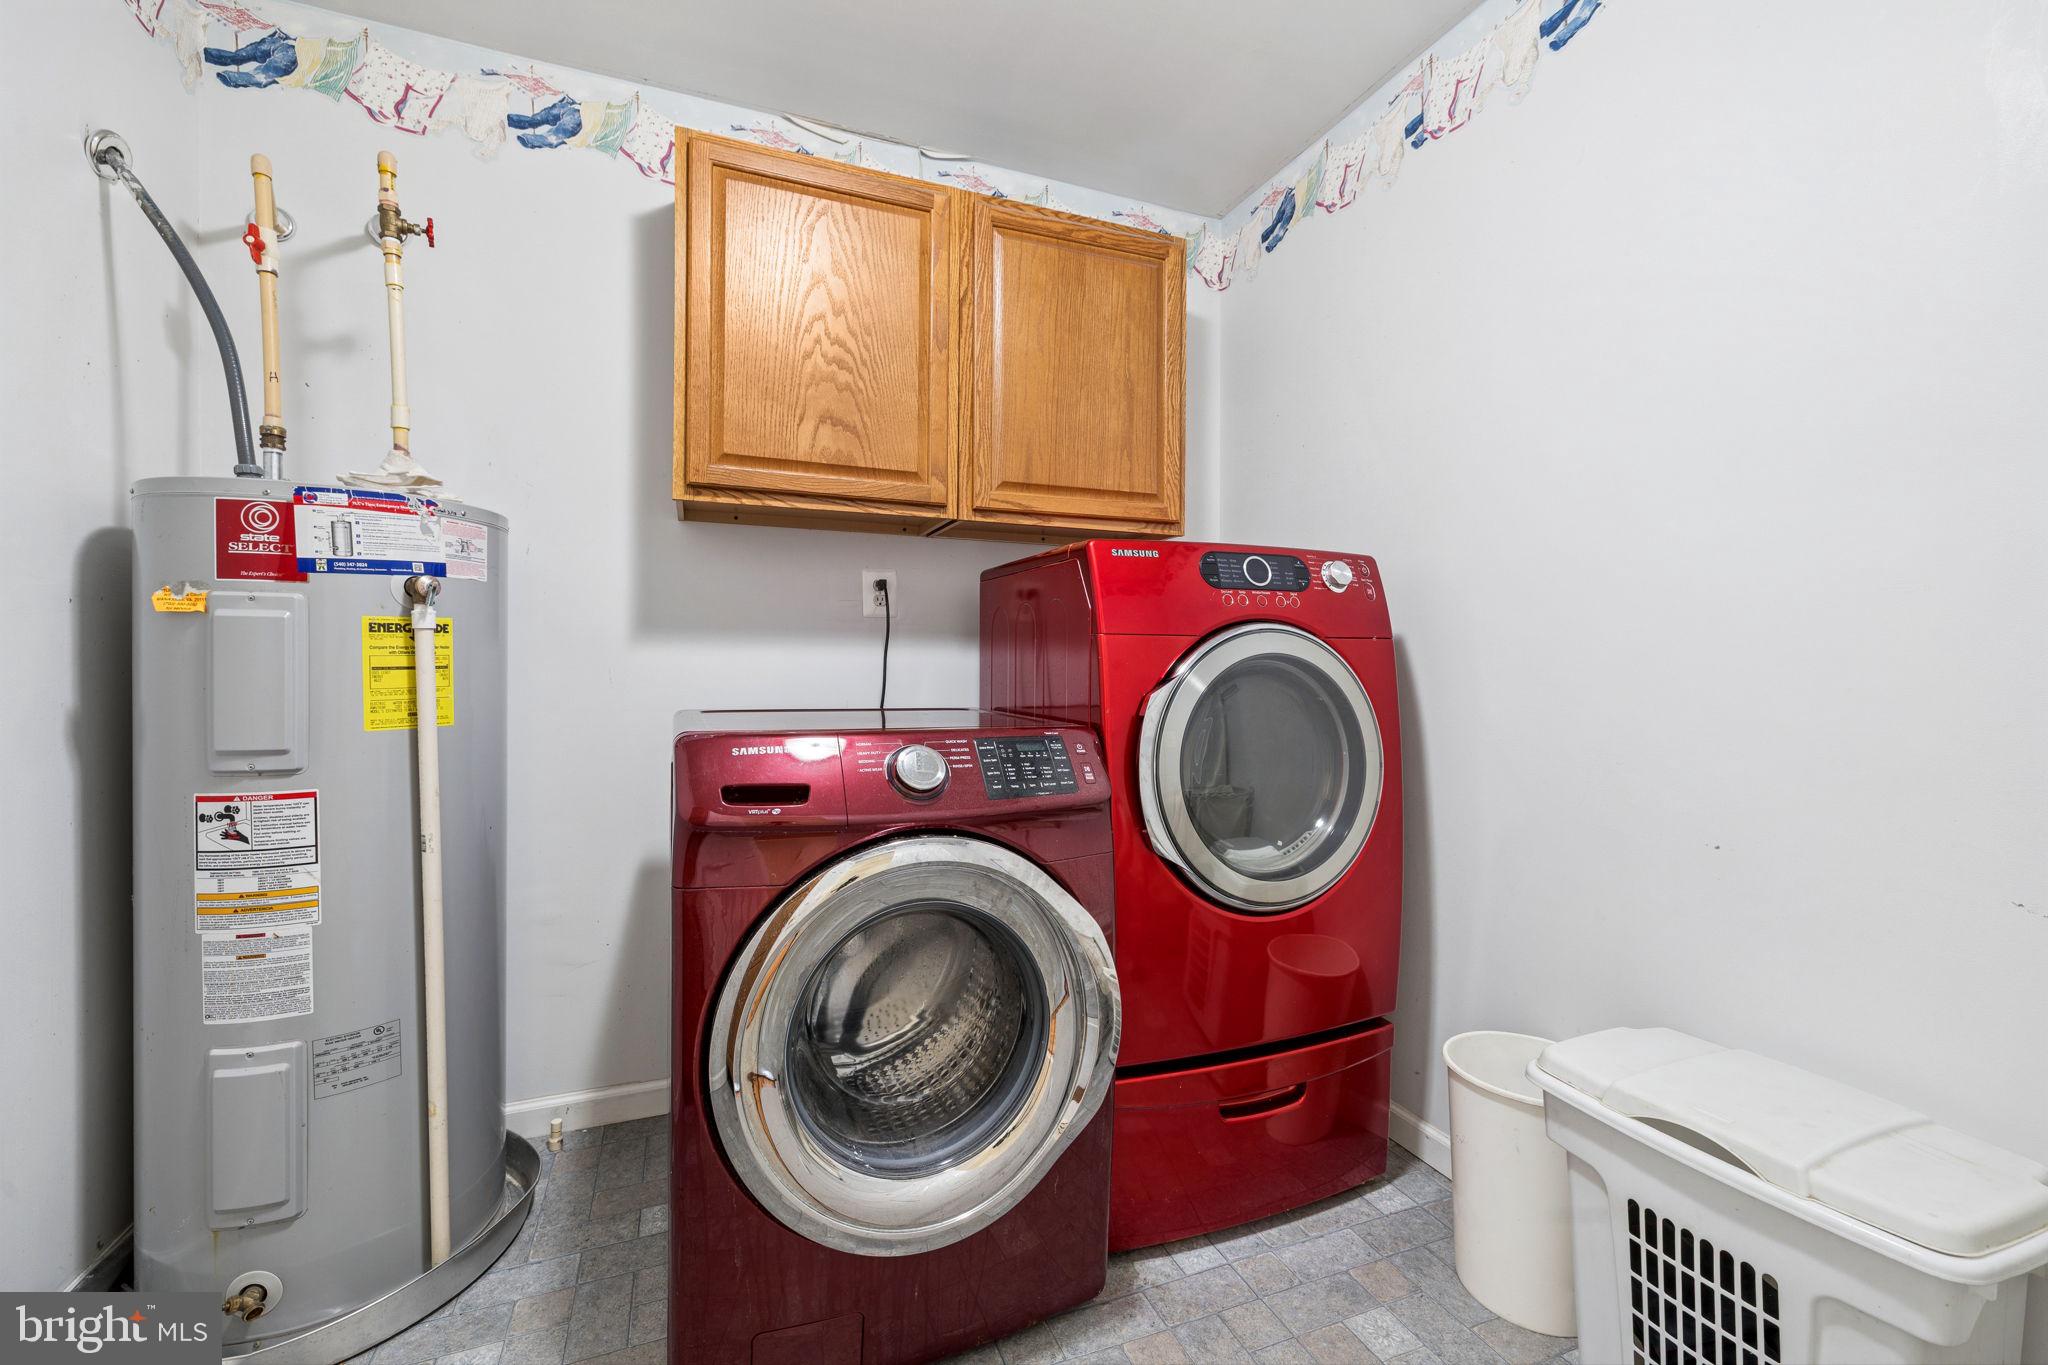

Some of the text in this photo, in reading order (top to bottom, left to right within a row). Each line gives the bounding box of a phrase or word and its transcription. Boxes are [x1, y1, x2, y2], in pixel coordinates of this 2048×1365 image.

[240, 533, 280, 542] state
[228, 541, 294, 552] SELECT
[1111, 548, 1160, 558] SAMSUNG
